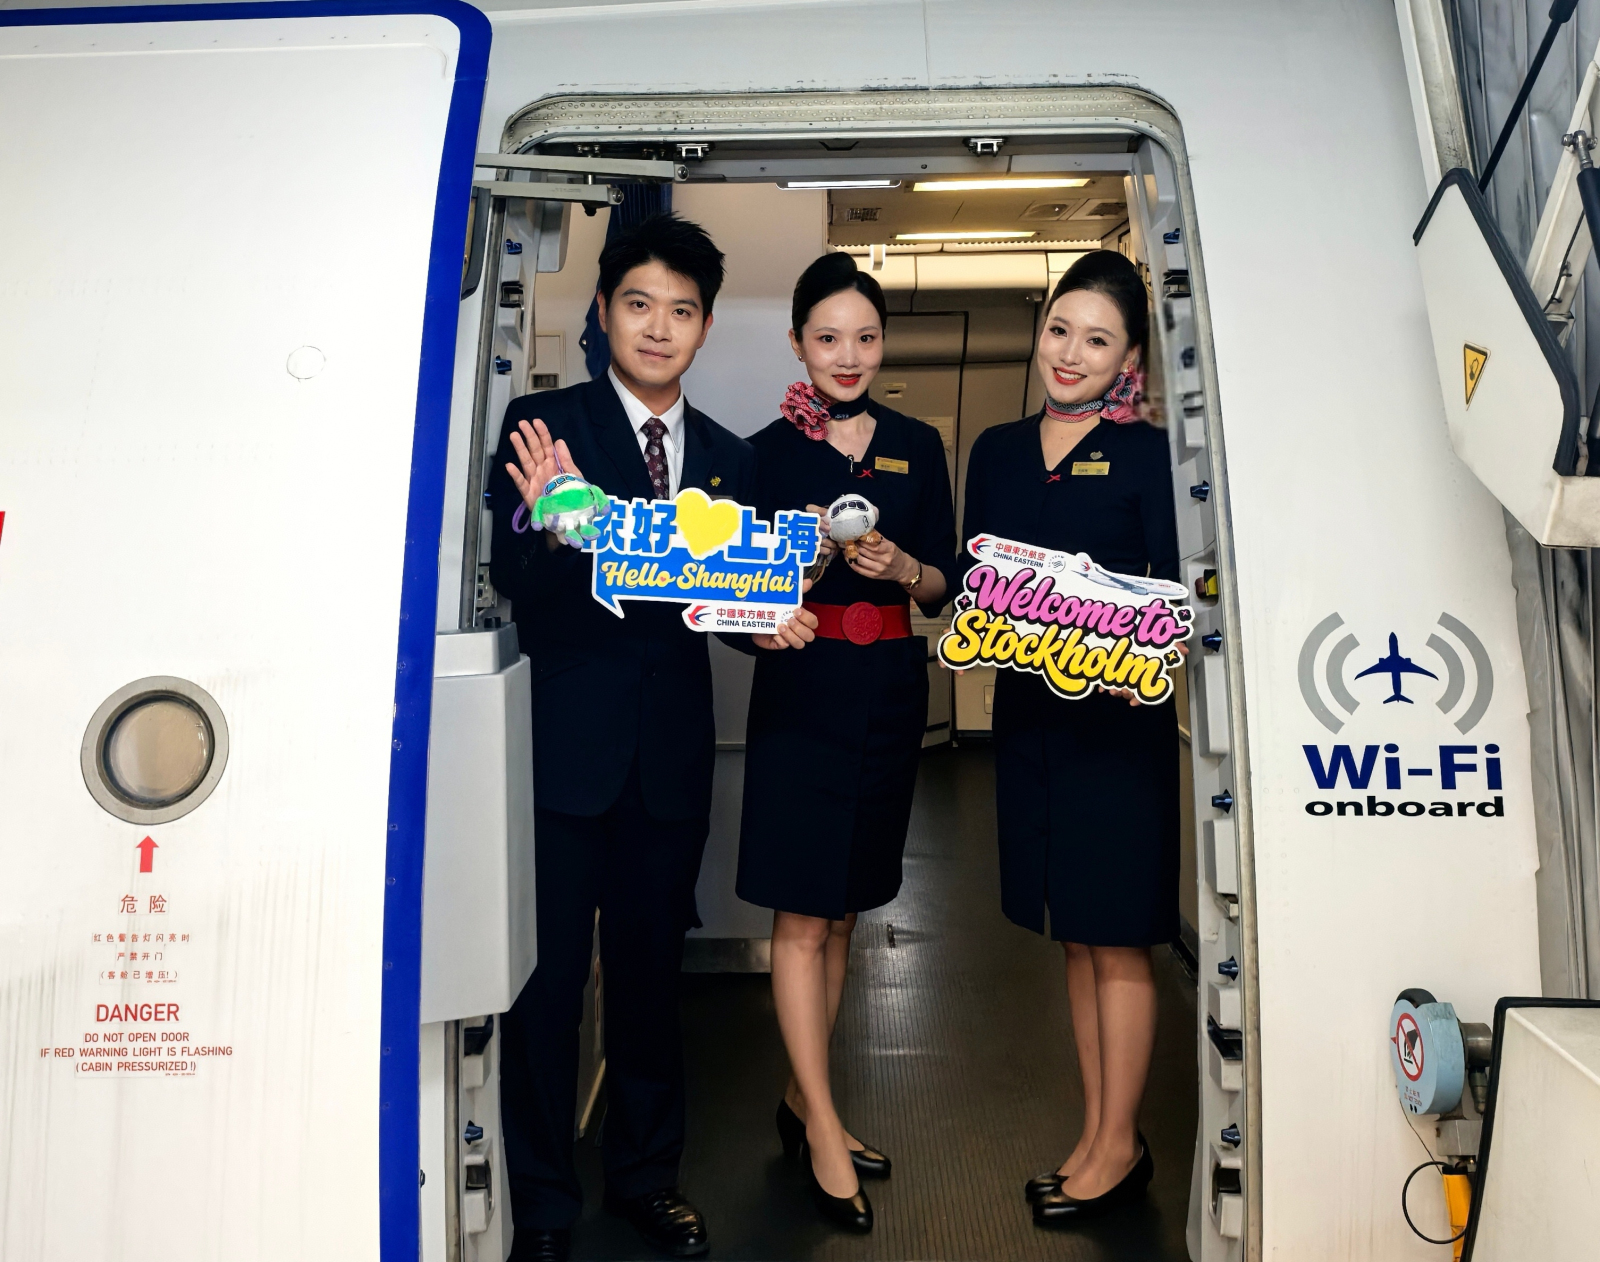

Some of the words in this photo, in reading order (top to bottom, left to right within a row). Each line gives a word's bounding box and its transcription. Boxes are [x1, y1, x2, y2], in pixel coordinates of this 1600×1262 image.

[727, 509, 818, 565] 上海
[993, 551, 1013, 561] CHINA
[1013, 556, 1044, 568] EASTERN
[995, 542, 1046, 562] 中國東方航空
[601, 561, 675, 587] Hello
[676, 562, 794, 598] ShangHai
[716, 607, 776, 621] 中國東方航空
[967, 565, 1136, 636] Welcome
[1136, 597, 1187, 647] to
[716, 619, 740, 627] CHINA
[741, 620, 776, 629] EASTERN
[942, 607, 1168, 697] Stockholm
[1302, 743, 1503, 790] Wi-Fi
[1304, 795, 1505, 818] onboard
[120, 893, 167, 914] 危险
[116, 952, 163, 961] 严禁开门
[95, 1003, 180, 1023] DANGER
[84, 1032, 99, 1043] DO
[103, 1032, 124, 1043] NOT
[127, 1032, 156, 1043] OPEN
[161, 1031, 190, 1042] DOOR
[40, 1048, 50, 1058] IF
[54, 1047, 75, 1058] RED
[79, 1047, 129, 1058] WARNING
[132, 1047, 163, 1057] LIGHT
[167, 1046, 177, 1057] IS
[181, 1046, 233, 1057] FLASHING
